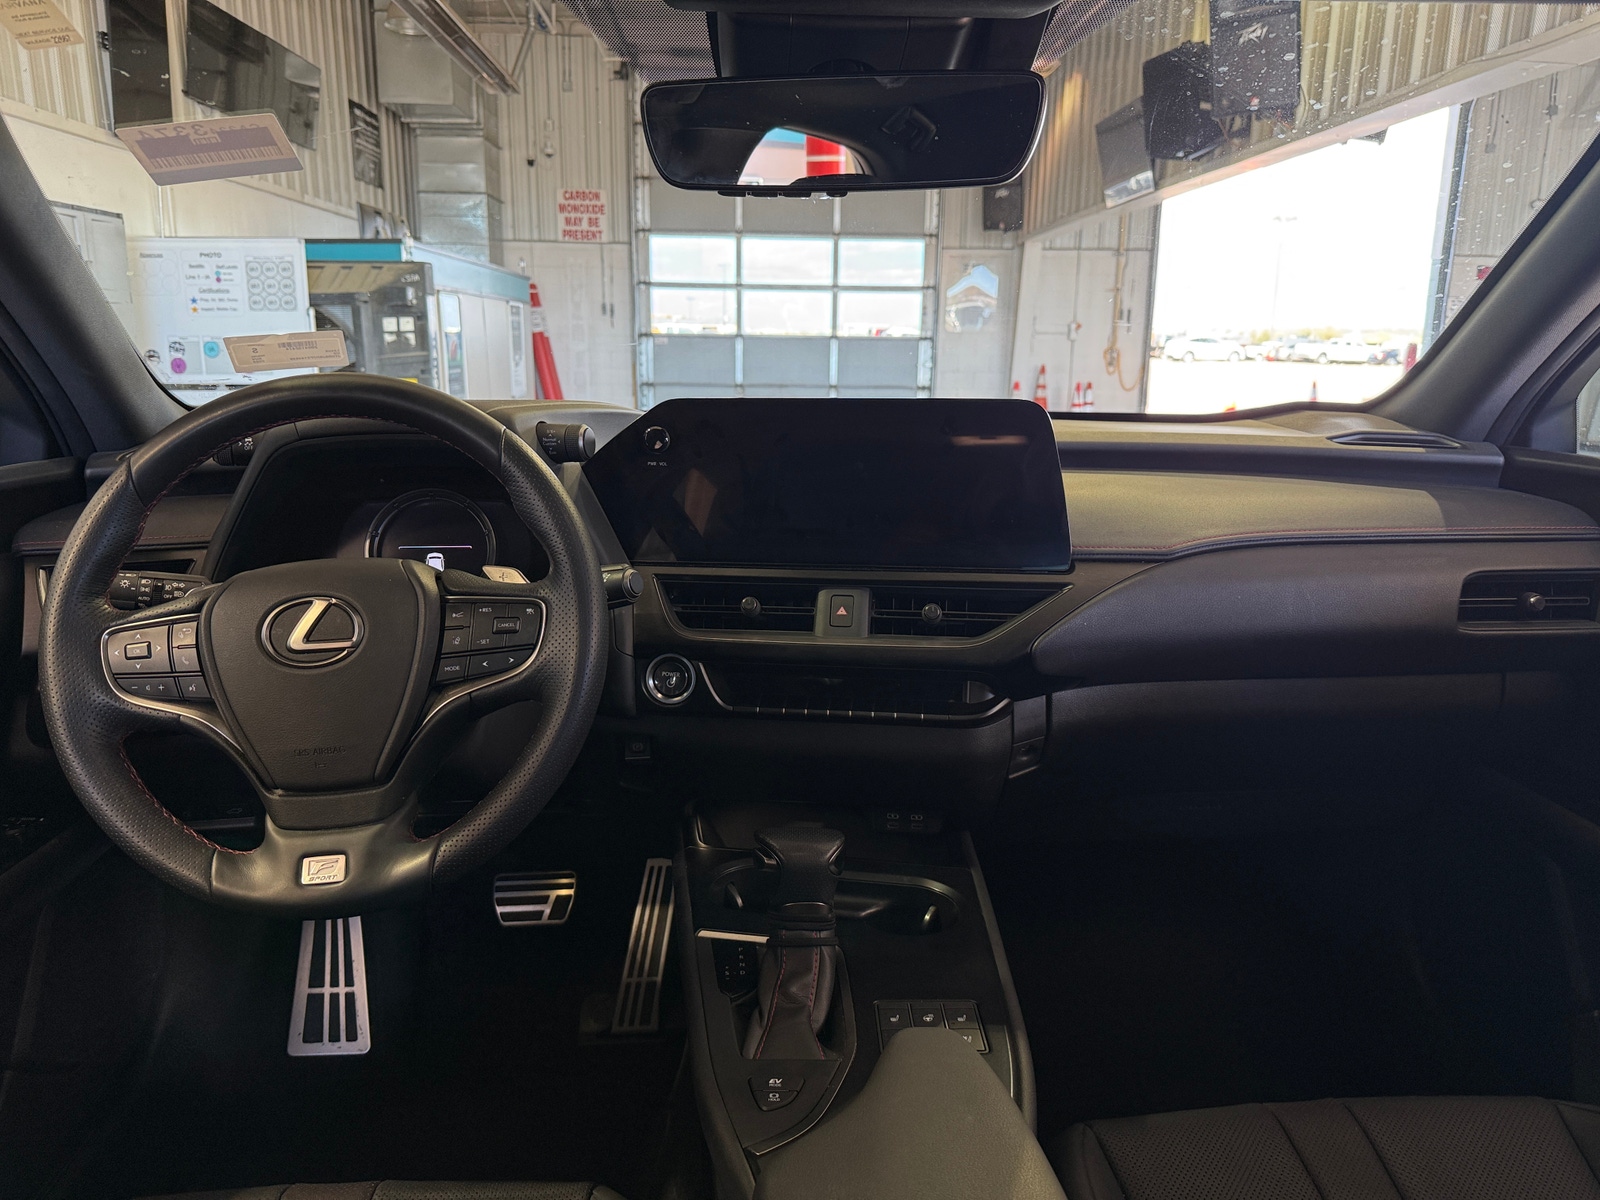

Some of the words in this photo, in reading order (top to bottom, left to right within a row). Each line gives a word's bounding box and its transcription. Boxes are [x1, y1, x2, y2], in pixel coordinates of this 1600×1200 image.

[563, 190, 600, 201] CARBON
[558, 203, 606, 215] MONOXIDE
[564, 216, 583, 227] MAY
[588, 217, 600, 227] BE
[562, 229, 603, 240] PRESENT
[313, 745, 347, 755] AIRBAG
[308, 874, 338, 882] SPORT
